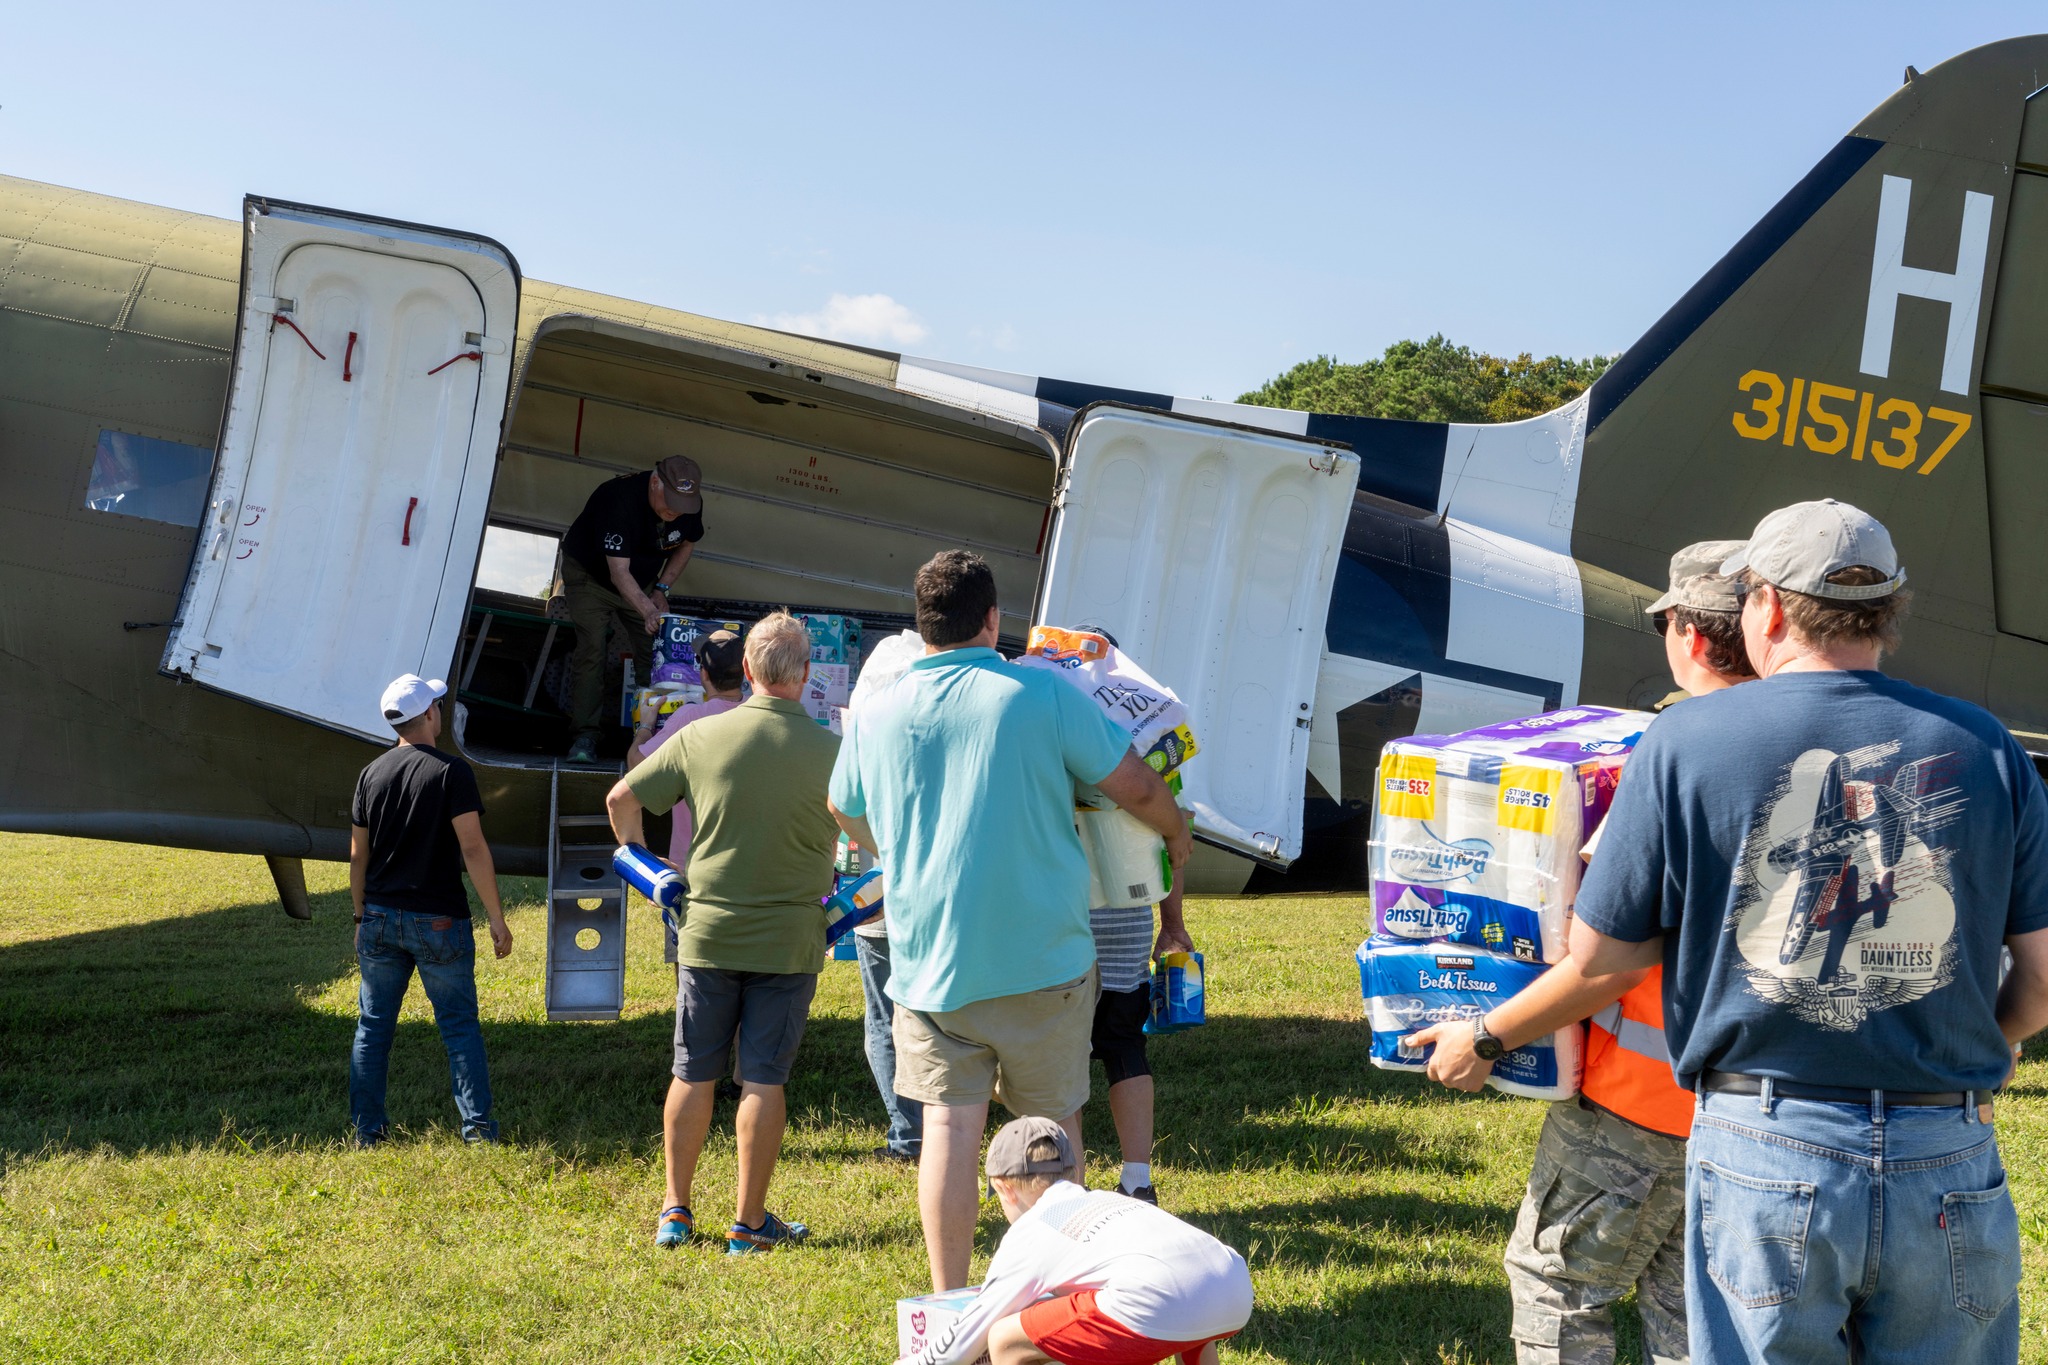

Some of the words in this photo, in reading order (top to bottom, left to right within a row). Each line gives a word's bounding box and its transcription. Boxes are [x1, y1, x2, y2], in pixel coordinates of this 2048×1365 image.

[1859, 174, 1995, 396] H
[1732, 369, 1973, 476] 315137
[808, 456, 817, 468] H
[789, 467, 809, 478] 1300
[1321, 467, 1340, 475] OPN
[776, 475, 790, 484] 125
[245, 504, 267, 513] OPEN
[238, 538, 260, 547] OPEN
[1166, 738, 1178, 766] QUILTED
[1408, 779, 1430, 796] 235
[1505, 795, 1530, 806] LARGE
[1531, 793, 1551, 808] 45
[1812, 842, 1838, 857] B-22
[1385, 908, 1433, 928] Tissue
[1861, 941, 1902, 950] DOUGLAS
[1436, 956, 1474, 966] KIRKLAND
[1860, 950, 1933, 967] DAUNTLESS
[1453, 971, 1498, 992] Tissue
[1511, 1051, 1537, 1067] 380
[1511, 1069, 1539, 1079] SHEETS
[911, 1336, 924, 1349] Dry
